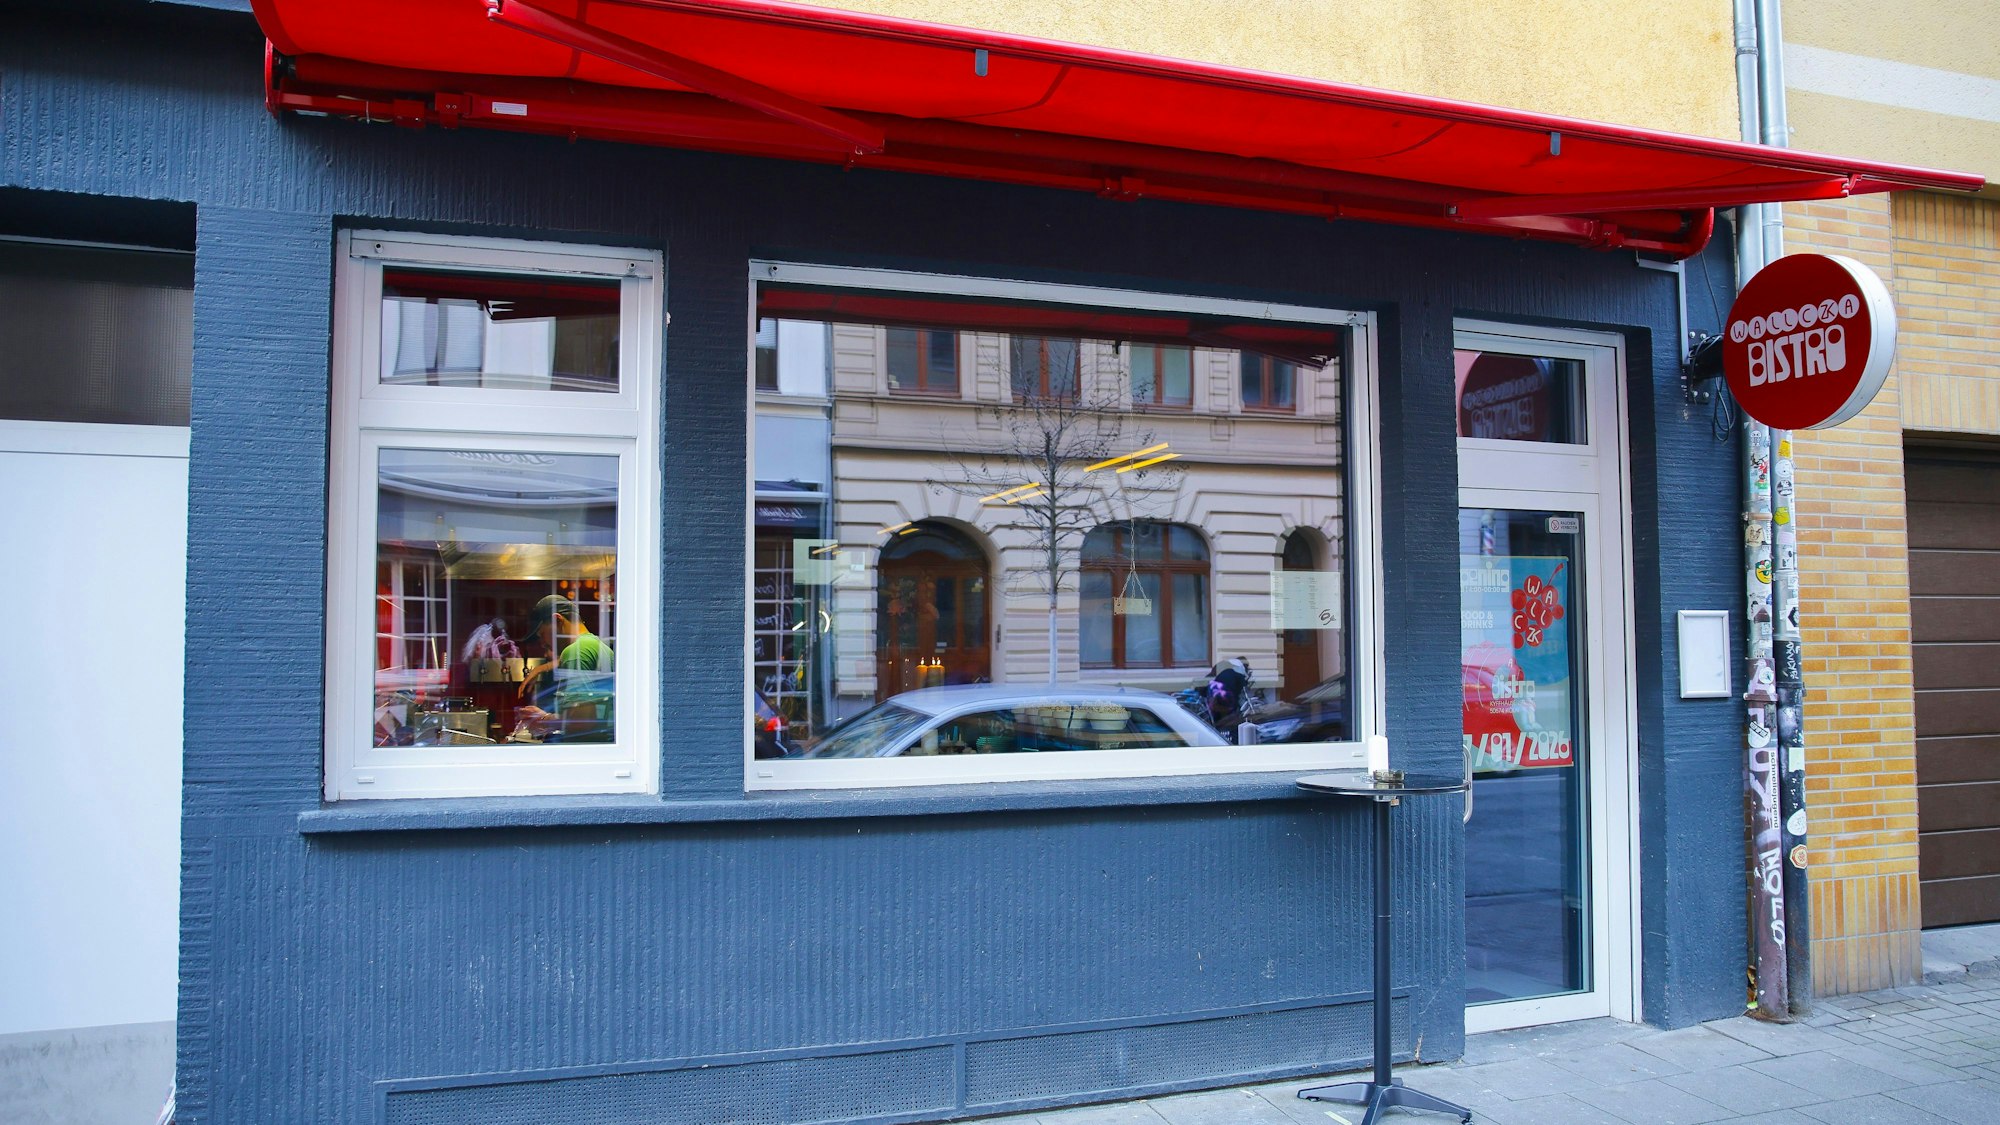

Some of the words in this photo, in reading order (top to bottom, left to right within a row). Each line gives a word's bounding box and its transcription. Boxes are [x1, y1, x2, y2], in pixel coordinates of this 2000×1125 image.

[1731, 296, 1858, 342] WALLCZKA
[1748, 324, 1847, 387] BISTRO
[1460, 561, 1510, 593] pening
[1461, 611, 1485, 620] FOOD
[1461, 620, 1494, 629] DRINKS
[1463, 731, 1570, 767] 7/01/2026
[1771, 751, 1779, 828] schnellejugend
